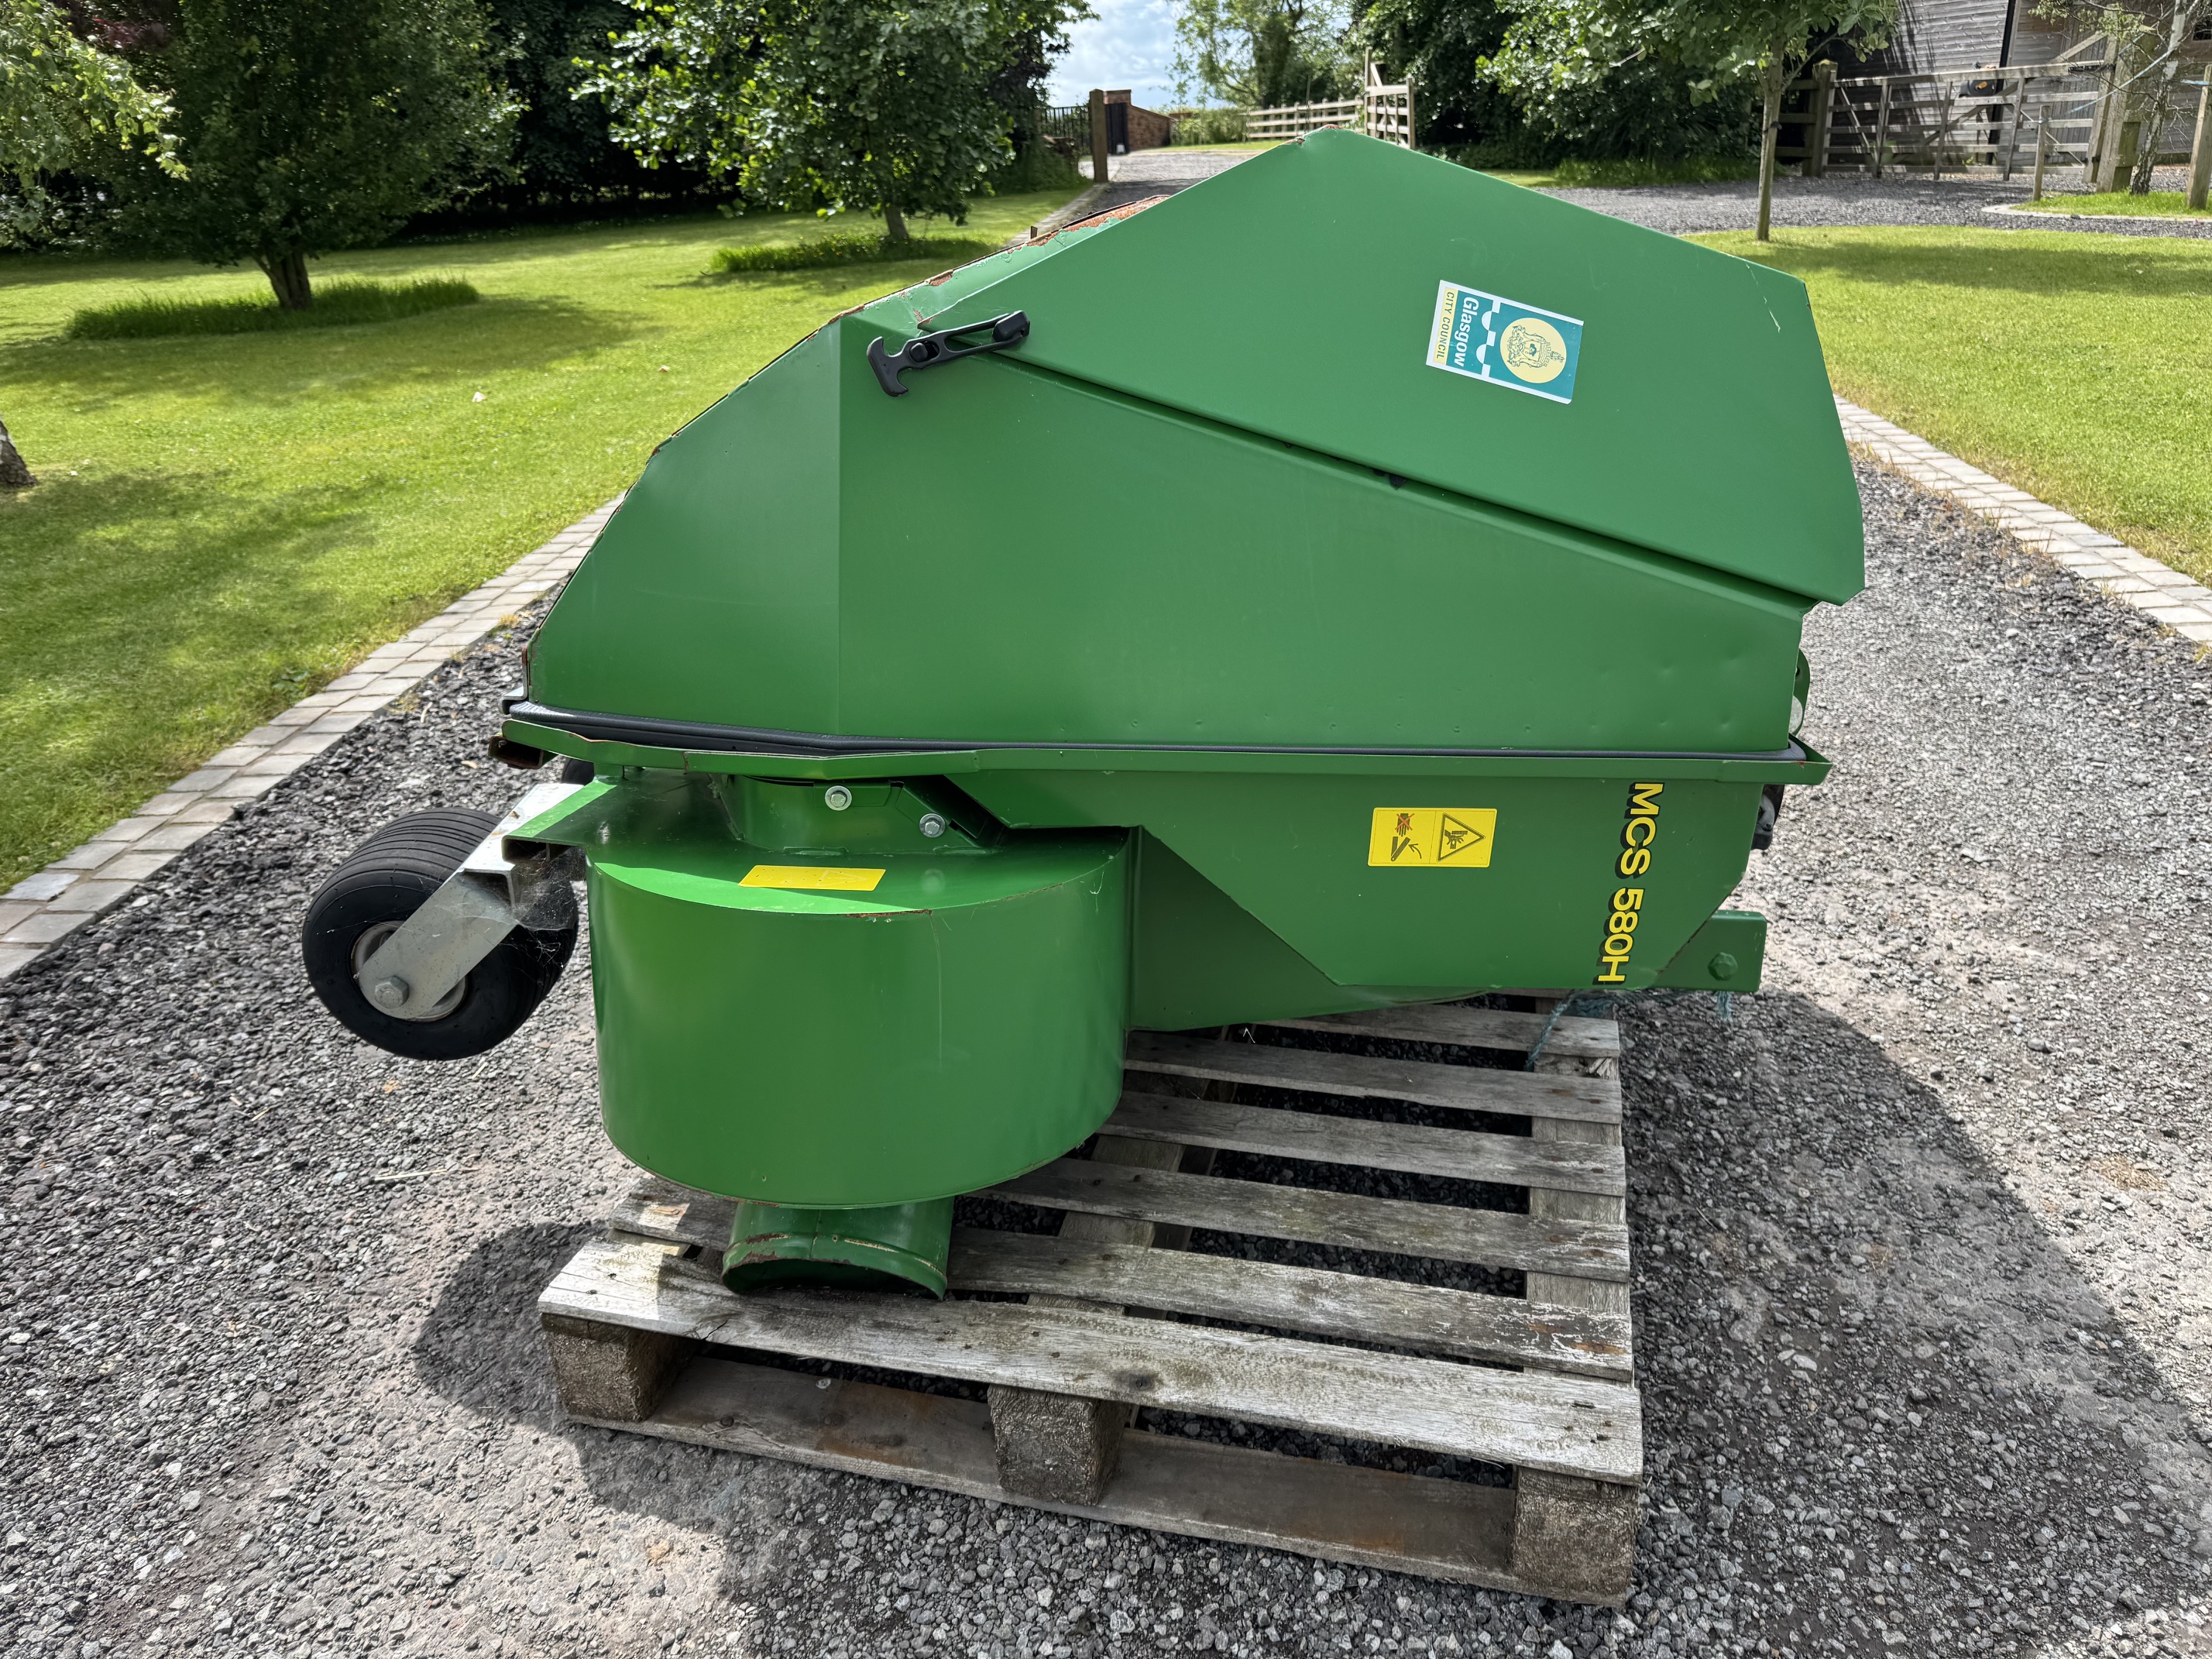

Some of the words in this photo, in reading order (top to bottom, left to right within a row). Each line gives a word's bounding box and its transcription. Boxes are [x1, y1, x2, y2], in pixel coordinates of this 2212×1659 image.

[1444, 291, 1455, 314] CITY
[1454, 297, 1479, 367] Glasgow
[1436, 317, 1451, 359] COUNCIL
[1618, 782, 1665, 878] MCS
[1595, 888, 1644, 984] 580H
